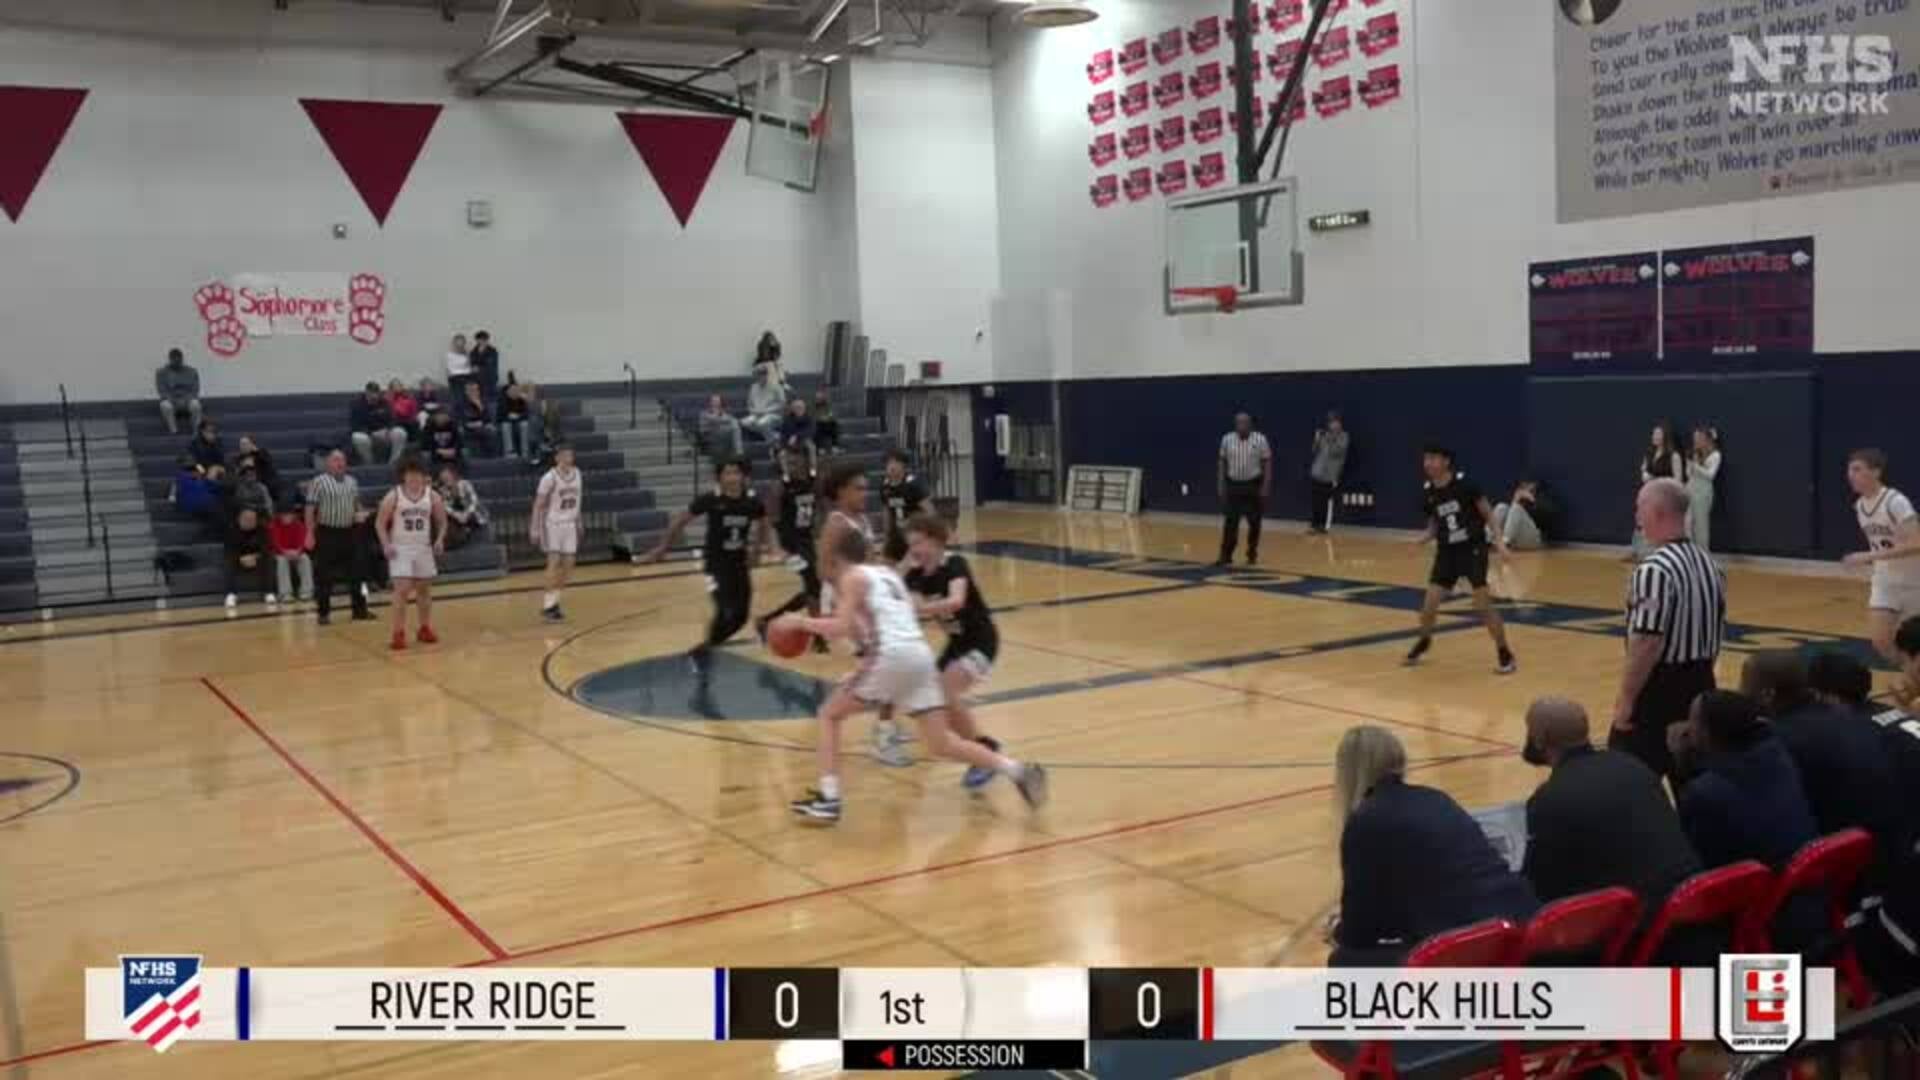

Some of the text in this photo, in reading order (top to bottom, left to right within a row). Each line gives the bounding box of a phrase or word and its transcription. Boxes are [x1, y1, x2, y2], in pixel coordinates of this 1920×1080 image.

[1590, 30, 1632, 53] Cheer
[1637, 24, 1661, 40] for
[1665, 17, 1690, 34] the
[1696, 9, 1725, 28] Red
[1591, 59, 1609, 75] To
[1613, 52, 1639, 76] you
[1646, 46, 1669, 63] the
[1674, 33, 1730, 57] Wolves
[1767, 13, 1827, 36] always
[1835, 5, 1857, 23] be
[1628, 74, 1657, 91] our
[1661, 62, 1698, 86] rally
[1638, 94, 1677, 113] down
[1654, 111, 1679, 133] the
[1593, 149, 1620, 169] Our
[1623, 138, 1679, 165] fighting
[1684, 134, 1723, 152] team
[1728, 122, 1758, 145] will
[1761, 120, 1791, 141] win
[1796, 114, 1835, 135] over
[1717, 149, 1769, 173] Wolves
[1773, 147, 1795, 170] go
[1798, 130, 1880, 160] marching
[1548, 266, 1638, 289] WOLVES
[1684, 254, 1790, 279] WOLVES
[239, 286, 346, 326] Sophomore
